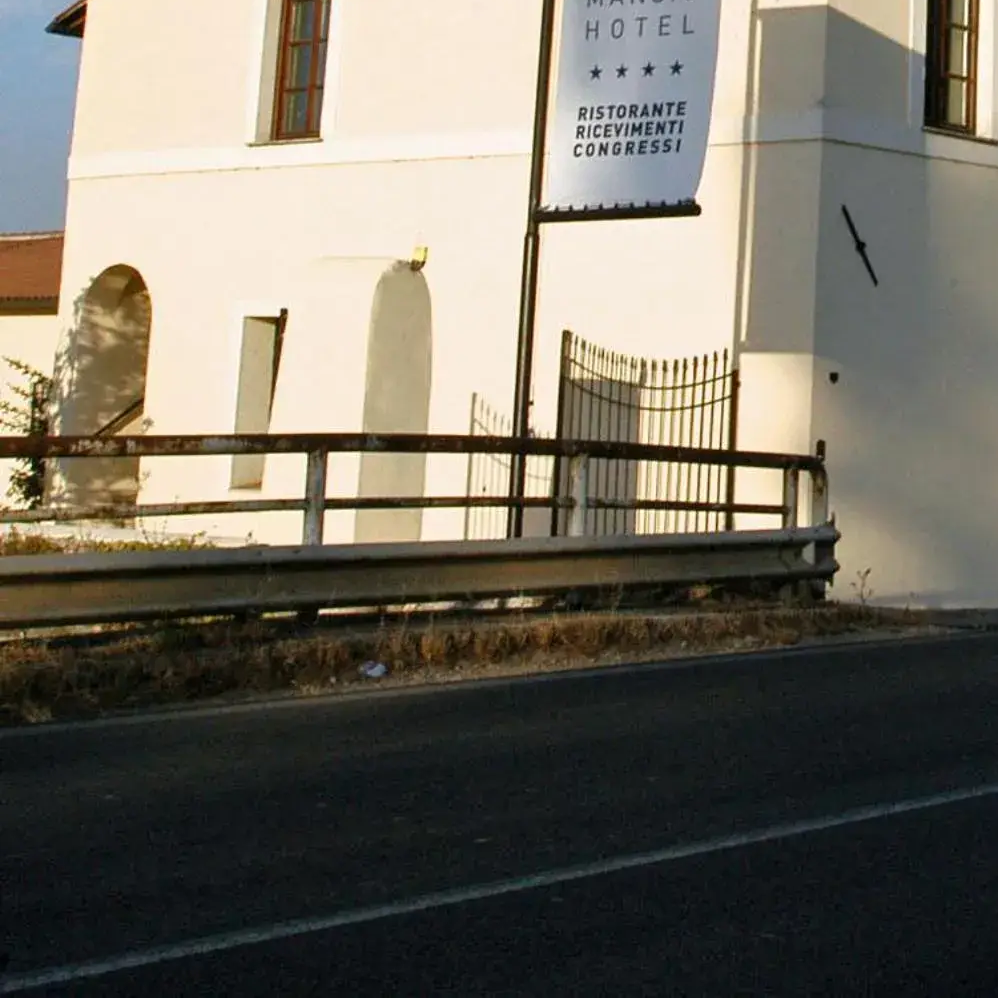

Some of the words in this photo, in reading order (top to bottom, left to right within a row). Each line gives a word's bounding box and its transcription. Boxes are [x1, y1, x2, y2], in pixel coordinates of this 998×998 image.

[585, 14, 695, 41] HOTEL
[577, 101, 687, 121] RISTORANTE
[575, 120, 684, 139] RICEVIMENTI
[573, 138, 682, 157] CONGRESSI
